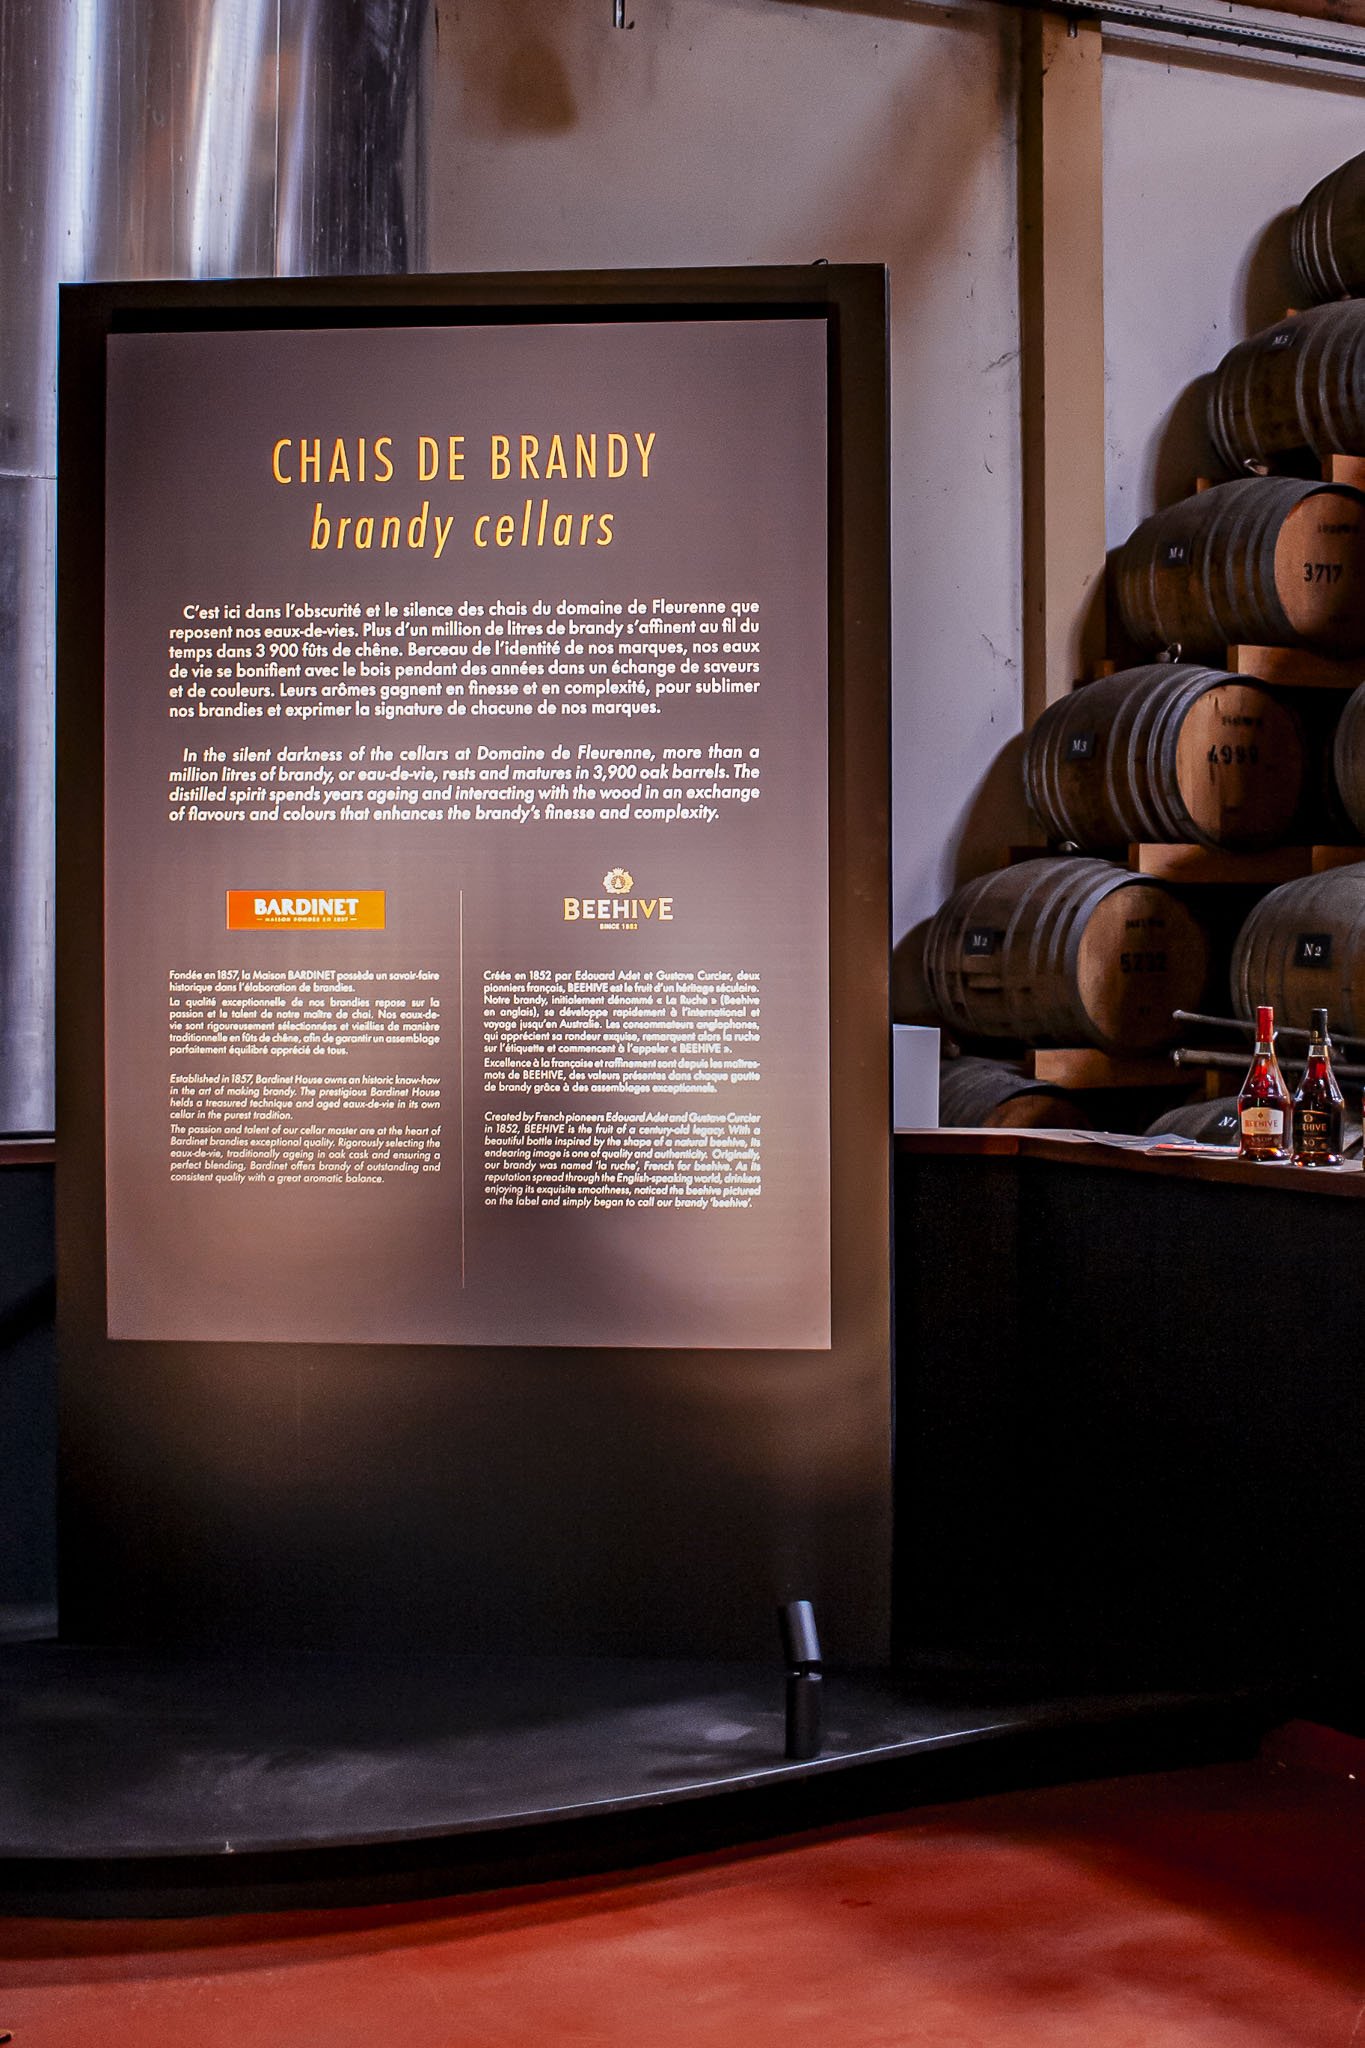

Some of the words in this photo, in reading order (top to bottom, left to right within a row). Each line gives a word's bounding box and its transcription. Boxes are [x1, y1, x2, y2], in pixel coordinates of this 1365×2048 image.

[272, 437, 394, 484] CHAIS
[418, 436, 466, 481] DE
[491, 432, 656, 480] BRANDY
[310, 501, 454, 558] brandy
[474, 499, 615, 547] cellars
[1303, 562, 1343, 583] 3717
[183, 605, 220, 618] C'est
[224, 604, 240, 618] ici
[245, 604, 280, 618] dans
[286, 603, 361, 617] l'obscurité
[366, 603, 380, 617] et
[385, 603, 398, 617] le
[403, 602, 453, 616] silence
[457, 602, 484, 616] des
[488, 602, 527, 615] chais
[532, 601, 550, 615] du
[556, 601, 622, 615] domaine
[627, 600, 646, 614] de
[652, 600, 725, 614] Fleurenne
[730, 603, 759, 617] que
[169, 624, 232, 642] reposent
[236, 627, 261, 637] nos
[264, 623, 358, 637] eaux-de-vies.
[363, 622, 391, 636] Plus
[394, 622, 427, 636] d'un
[432, 622, 481, 635] million
[484, 621, 503, 635] de
[507, 621, 542, 635] litres
[546, 621, 565, 635] de
[569, 620, 623, 638] brandy
[626, 620, 696, 634] s'affinent
[699, 623, 718, 633] au
[721, 619, 736, 633] fil
[740, 619, 759, 633] du
[168, 643, 212, 661] temps
[216, 643, 252, 657] dans
[255, 643, 265, 657] 3
[269, 643, 298, 657] 900
[302, 642, 328, 656] fûts
[332, 642, 351, 656] de
[355, 642, 402, 656] chêne.
[408, 642, 467, 655] Berceau
[472, 641, 490, 655] de
[495, 641, 560, 655] l'identité
[564, 641, 583, 654] de
[588, 644, 613, 654] nos
[618, 644, 687, 658] marques,
[692, 644, 718, 653] nos
[722, 643, 760, 653] eaux
[183, 747, 197, 761] In
[203, 747, 226, 761] the
[233, 747, 271, 761] silent
[277, 747, 342, 761] darkness
[349, 747, 365, 760] of
[370, 746, 393, 760] the
[400, 746, 448, 760] cellars
[455, 746, 471, 760] at
[477, 746, 544, 760] Domaine
[551, 746, 570, 759] de
[577, 745, 655, 763] Fleurenne,
[663, 749, 701, 759] more
[707, 745, 742, 759] than
[749, 749, 759, 759] a
[1072, 739, 1087, 752] M3
[169, 768, 218, 782] million
[221, 768, 256, 781] litres
[259, 767, 276, 781] of
[278, 767, 334, 785] brandy,
[338, 771, 354, 781] or
[358, 767, 438, 784] eau-de-vie,
[442, 766, 475, 780] rests
[479, 766, 509, 780] and
[513, 766, 572, 780] matures
[575, 766, 589, 779] in
[592, 765, 636, 783] 3,900
[639, 765, 669, 779] oak
[672, 765, 730, 779] barrels.
[732, 765, 759, 778] The
[254, 898, 359, 916] BARDINET
[563, 897, 673, 921] BEEHIVE
[972, 934, 988, 947] M2
[169, 970, 202, 980] Fondée
[217, 970, 239, 982] 1857,
[241, 971, 250, 980] la
[252, 971, 286, 980] Maison
[288, 971, 335, 980] BARDINET
[336, 971, 374, 982] possède
[389, 971, 439, 980] savoir-faire
[483, 971, 511, 980] Créée
[529, 971, 551, 980] 1852
[554, 974, 572, 982] par
[575, 971, 614, 980] Edouard
[617, 971, 640, 980] Adet
[643, 971, 653, 980] et
[656, 971, 693, 980] Gustave
[697, 971, 732, 982] Curcier,
[736, 971, 760, 980] deux
[169, 982, 212, 994] historique
[214, 982, 236, 992] dans
[298, 983, 310, 992] de
[313, 983, 355, 992] brandies.
[169, 1074, 220, 1084] Established
[221, 1074, 229, 1084] in
[231, 1074, 253, 1086] 1857,
[255, 1075, 293, 1084] Bardinet
[294, 1075, 322, 1084] House
[362, 1075, 393, 1084] historic
[395, 1075, 440, 1084] know-how
[484, 1124, 492, 1134] in
[496, 1124, 520, 1136] 1852,
[524, 1124, 564, 1134] BEEHIVE
[567, 1124, 575, 1134] is
[577, 1125, 592, 1134] the
[595, 1125, 613, 1134] fruit
[616, 1125, 626, 1134] of
[639, 1125, 689, 1136] century-old
[693, 1125, 725, 1136] legacy.
[729, 1125, 750, 1135] With
[170, 1148, 223, 1160] eaux-de-vie,
[227, 1149, 279, 1160] traditionally
[283, 1149, 313, 1161] ageing
[317, 1149, 325, 1159] in
[329, 1149, 346, 1159] oak
[349, 1149, 369, 1159] cask
[371, 1149, 390, 1159] and
[393, 1150, 430, 1161] ensuring
